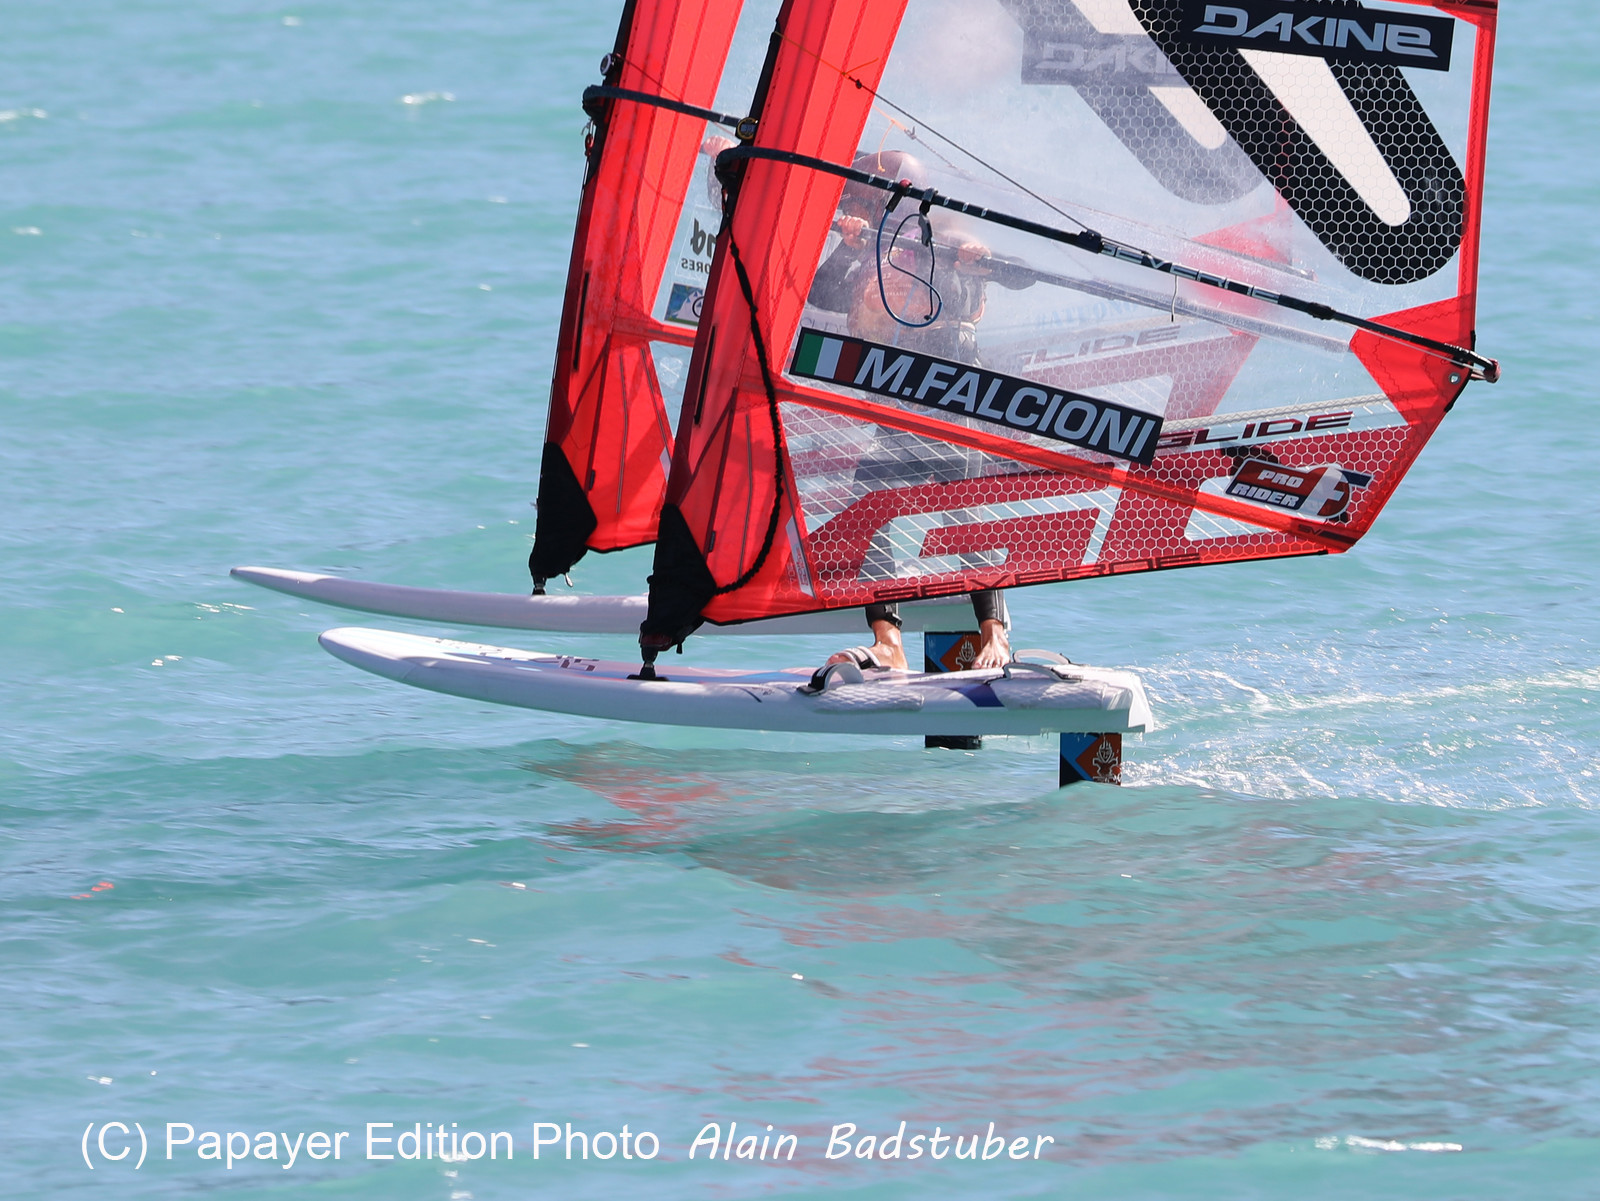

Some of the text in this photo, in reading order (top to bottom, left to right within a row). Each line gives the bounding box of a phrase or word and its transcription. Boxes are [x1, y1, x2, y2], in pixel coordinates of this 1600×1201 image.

[853, 347, 1156, 458] M.FALCIONI
[1231, 482, 1300, 508] RIDER
[1257, 469, 1304, 488] PRO
[873, 552, 1201, 600] SEVERNE
